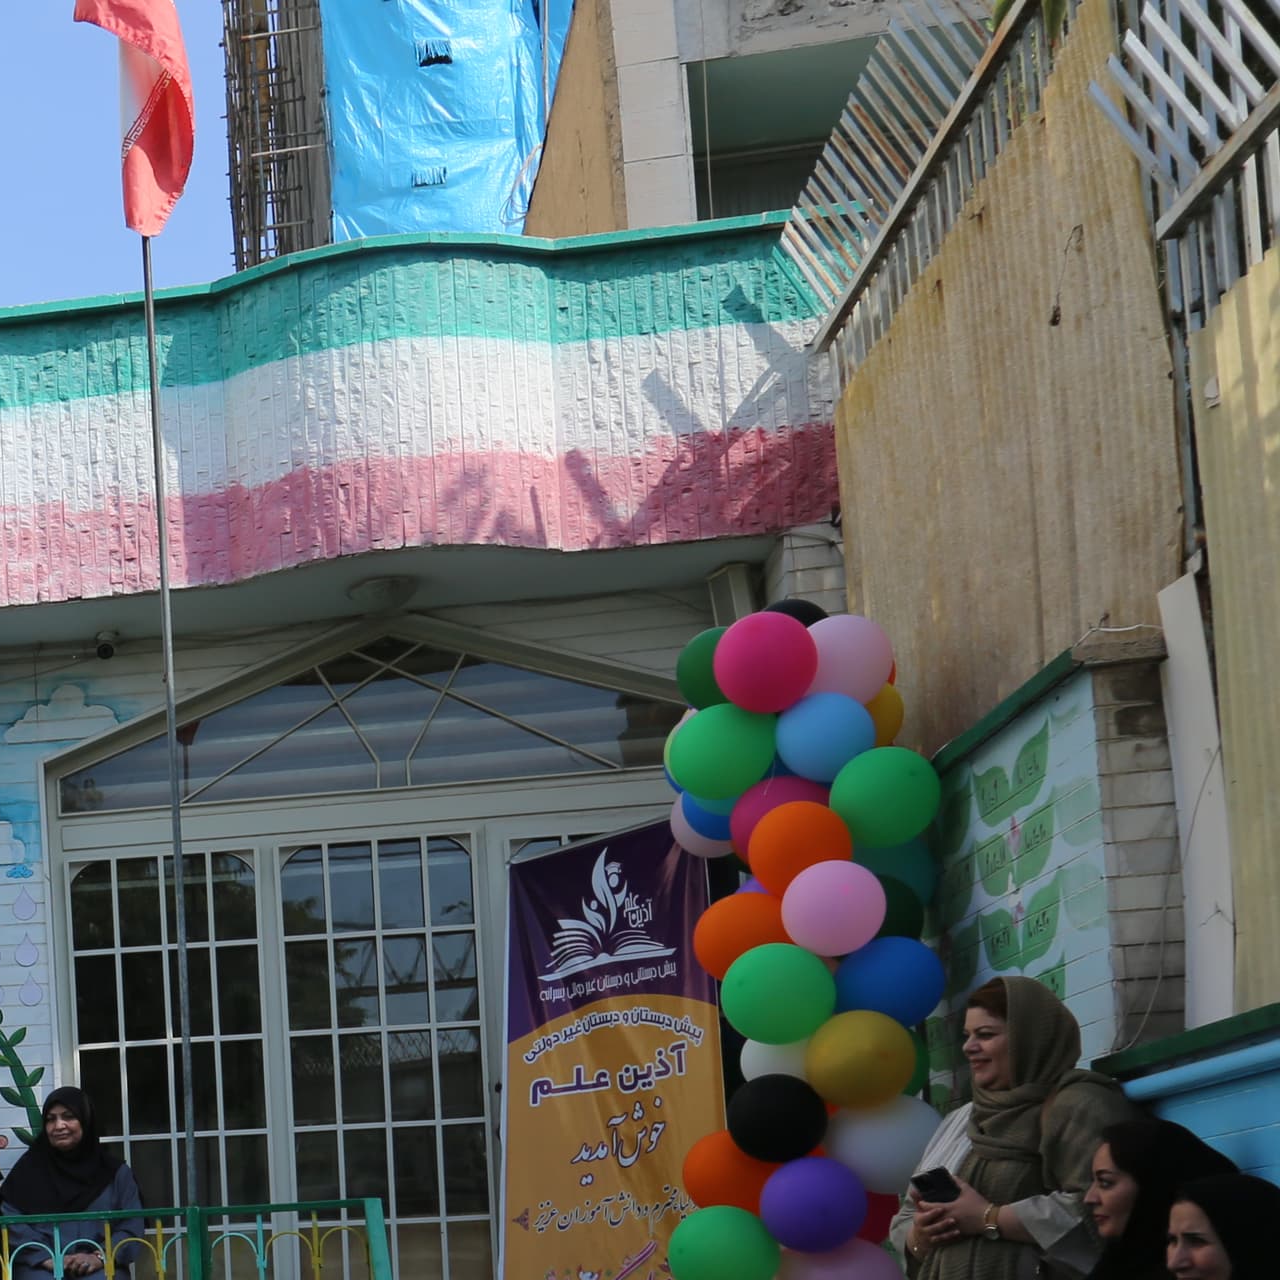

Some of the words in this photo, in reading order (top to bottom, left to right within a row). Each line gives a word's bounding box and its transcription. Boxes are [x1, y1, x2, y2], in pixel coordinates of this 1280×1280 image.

[628, 898, 653, 928] آذین
[561, 1021, 584, 1042] غیر
[582, 1010, 620, 1034] دبستان
[622, 1012, 630, 1026] و
[631, 1006, 673, 1031] دبستان
[674, 1016, 704, 1046] پیش
[523, 1032, 561, 1063] دولتی
[618, 1040, 688, 1093] آذین
[529, 1065, 610, 1107] علم
[618, 1096, 666, 1167] خوش
[571, 1112, 628, 1186] آمدید
